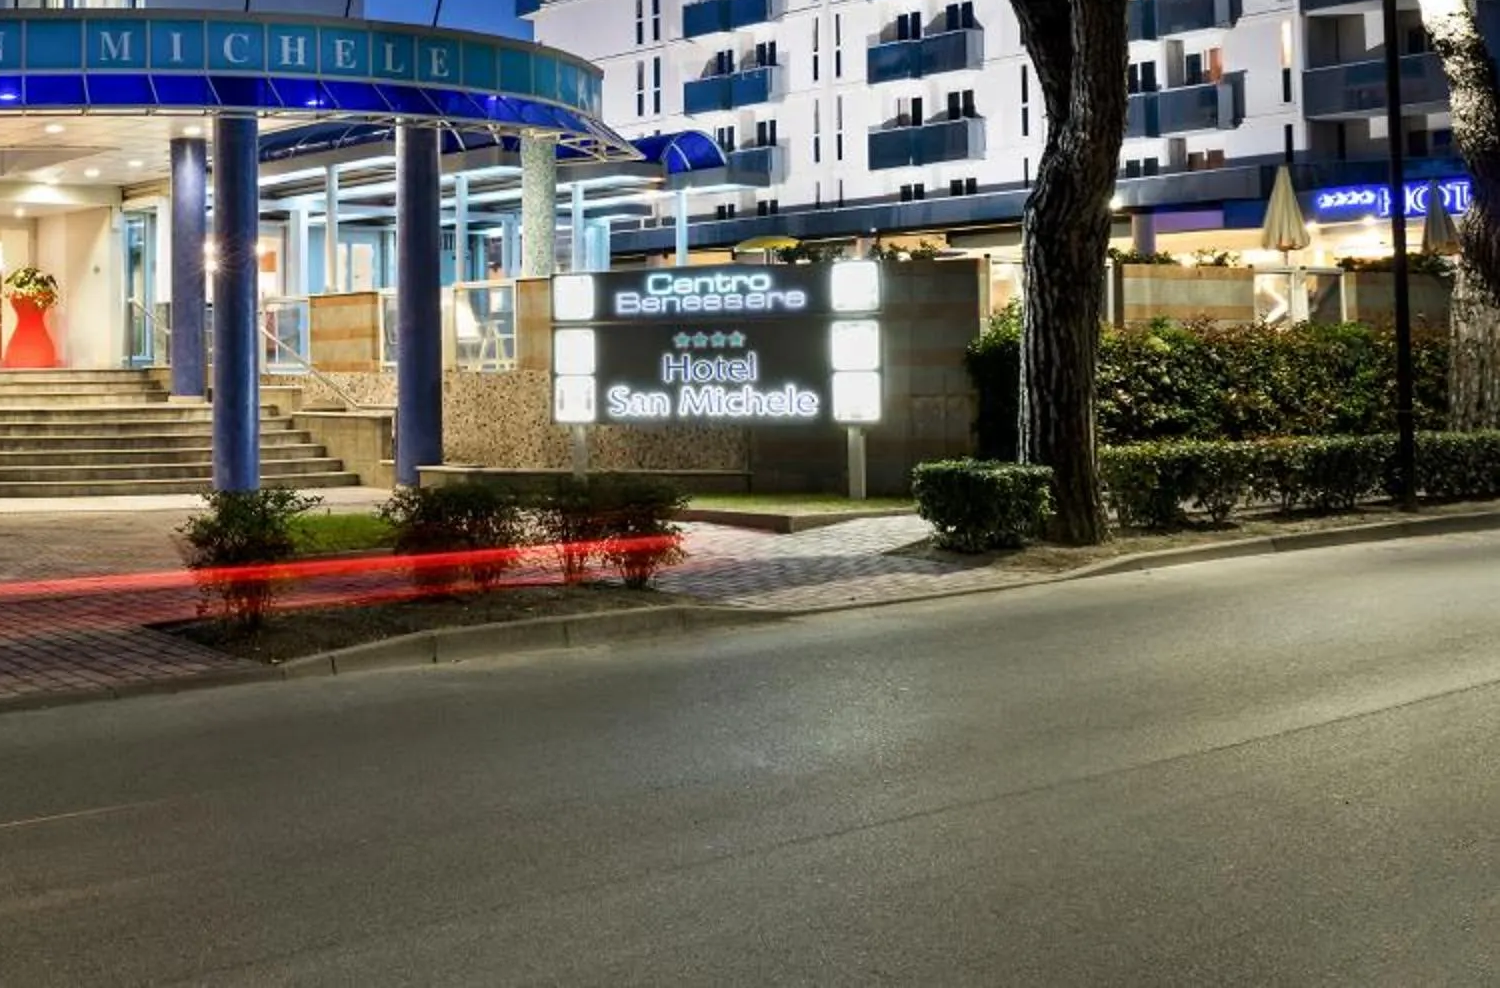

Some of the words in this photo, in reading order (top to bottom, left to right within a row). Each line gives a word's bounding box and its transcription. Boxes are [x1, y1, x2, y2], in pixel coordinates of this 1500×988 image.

[100, 30, 450, 79] MICHELE
[646, 272, 773, 296] Centro
[614, 290, 807, 315] Benessere
[662, 350, 759, 383] Hotel
[607, 385, 672, 418] San
[678, 385, 820, 418] Michele
